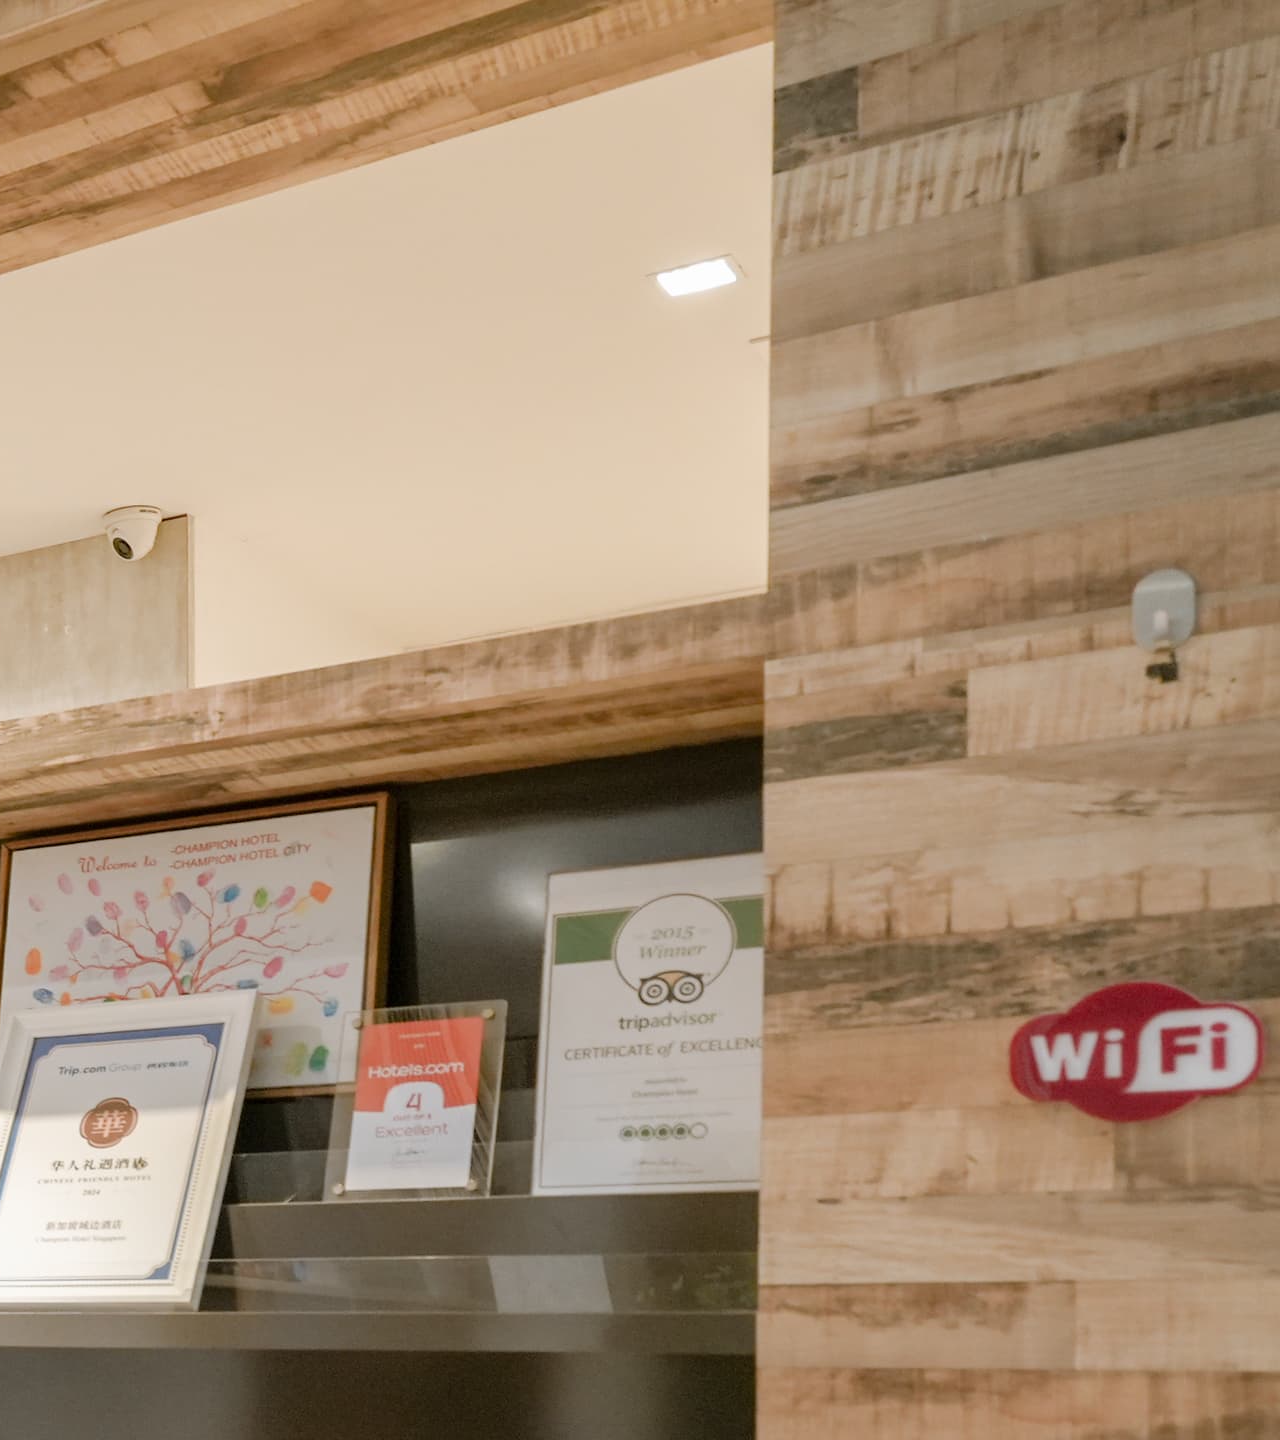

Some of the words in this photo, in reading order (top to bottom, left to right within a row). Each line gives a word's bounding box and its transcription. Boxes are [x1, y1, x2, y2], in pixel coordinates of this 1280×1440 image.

[241, 833, 280, 845] HOTEL
[240, 849, 279, 862] HOTEL
[283, 843, 312, 857] CITY
[78, 856, 137, 873] Welcome
[144, 856, 157, 867] to
[649, 926, 696, 941] 2015
[639, 944, 707, 960] Winner
[618, 1012, 718, 1032] tripadvisor
[564, 1043, 654, 1061] CERTIFICATE
[657, 1041, 674, 1058] of
[1030, 1022, 1230, 1083] WiFi
[58, 1066, 107, 1077] Trip.com
[108, 1063, 142, 1074] Group
[368, 1061, 465, 1079] Hotels.com
[406, 1093, 422, 1111] 4
[91, 1110, 127, 1138] 華
[376, 1122, 449, 1138] Excellent
